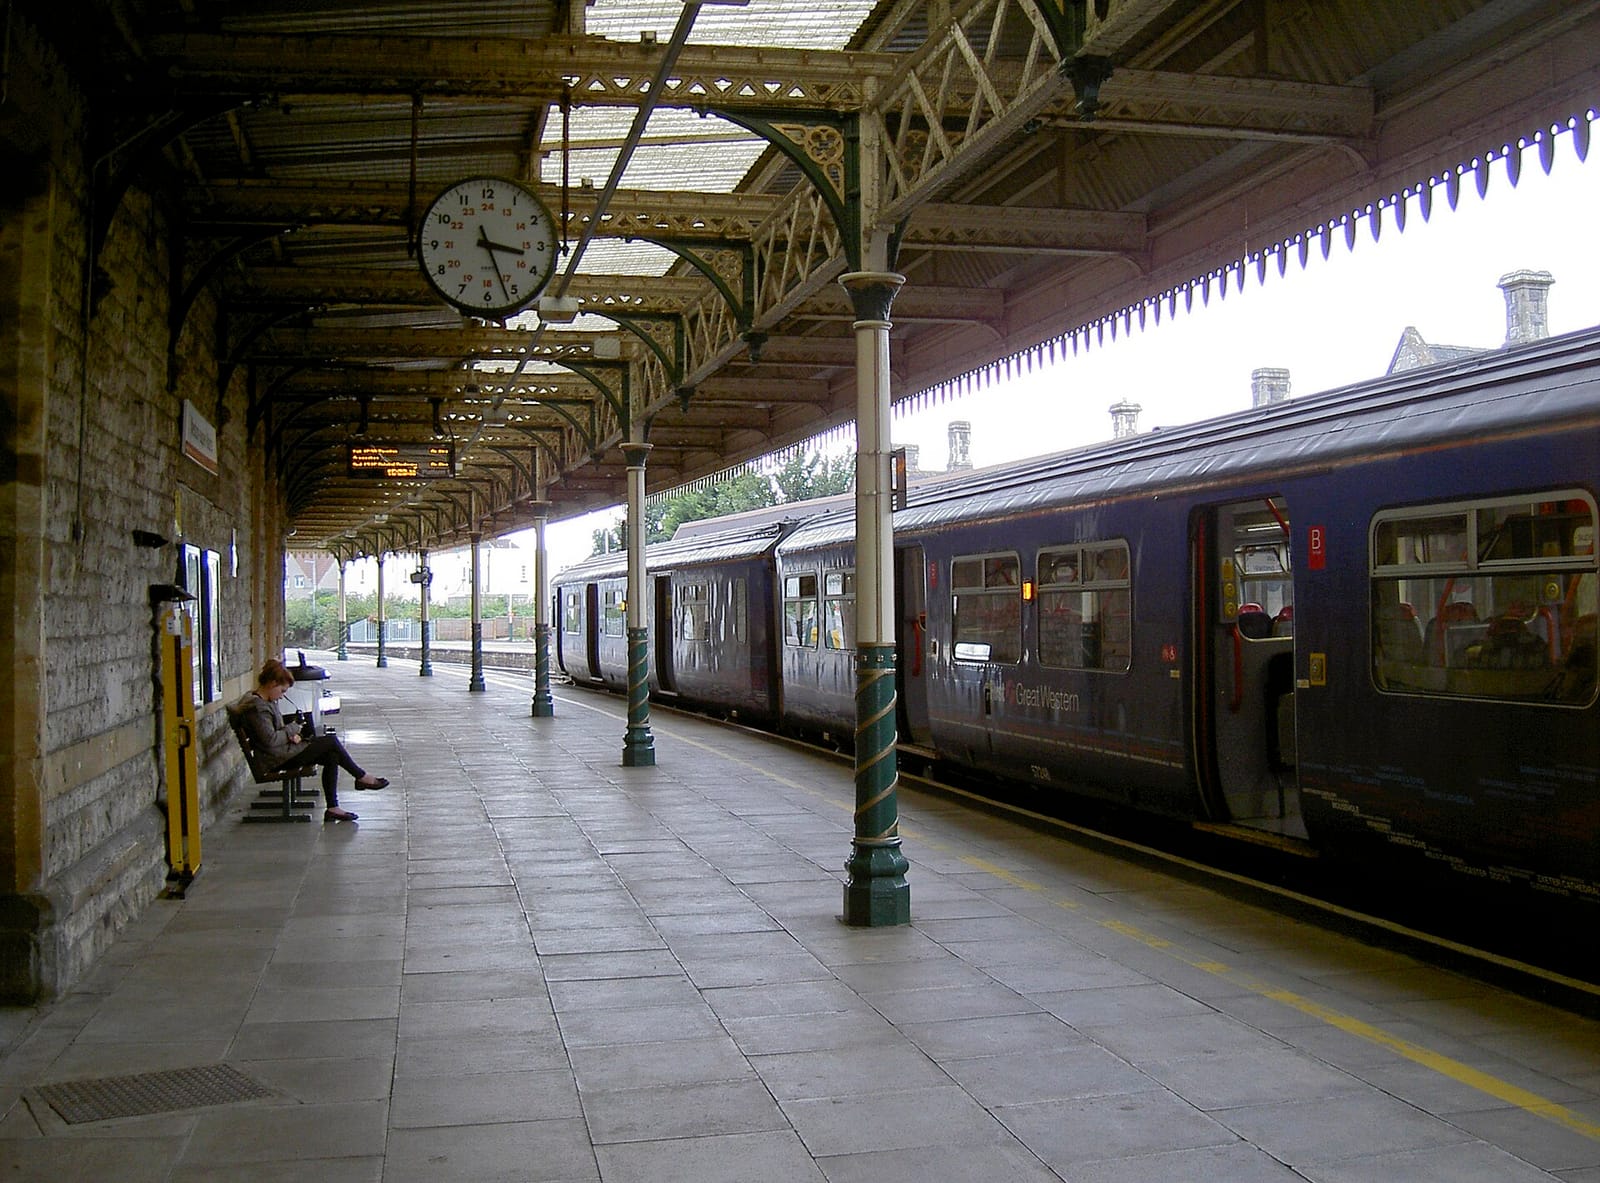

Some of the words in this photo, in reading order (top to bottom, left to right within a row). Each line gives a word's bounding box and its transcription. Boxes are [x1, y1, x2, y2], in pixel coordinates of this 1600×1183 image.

[482, 189, 494, 199] 12
[460, 195, 468, 205] 11
[513, 195, 516, 206] 1
[462, 208, 475, 216] 23
[481, 203, 494, 211] 24
[503, 208, 512, 216] 13
[438, 214, 450, 224] 10
[530, 215, 538, 225] 2
[450, 222, 464, 230] 22
[516, 223, 525, 231] 14
[431, 240, 439, 250] 9
[444, 240, 454, 249] 21
[522, 241, 531, 249] 15
[536, 241, 545, 251] 3
[447, 260, 460, 268] 20
[516, 261, 526, 269] 16
[438, 264, 446, 275] 8
[529, 265, 538, 276] 4
[502, 274, 511, 282] 17
[458, 284, 467, 294] 7
[483, 280, 492, 288] 18
[510, 284, 518, 295] 5
[483, 291, 492, 302] 6
[1311, 529, 1321, 549] B
[1015, 682, 1040, 707] Great
[1040, 684, 1080, 713] Western
